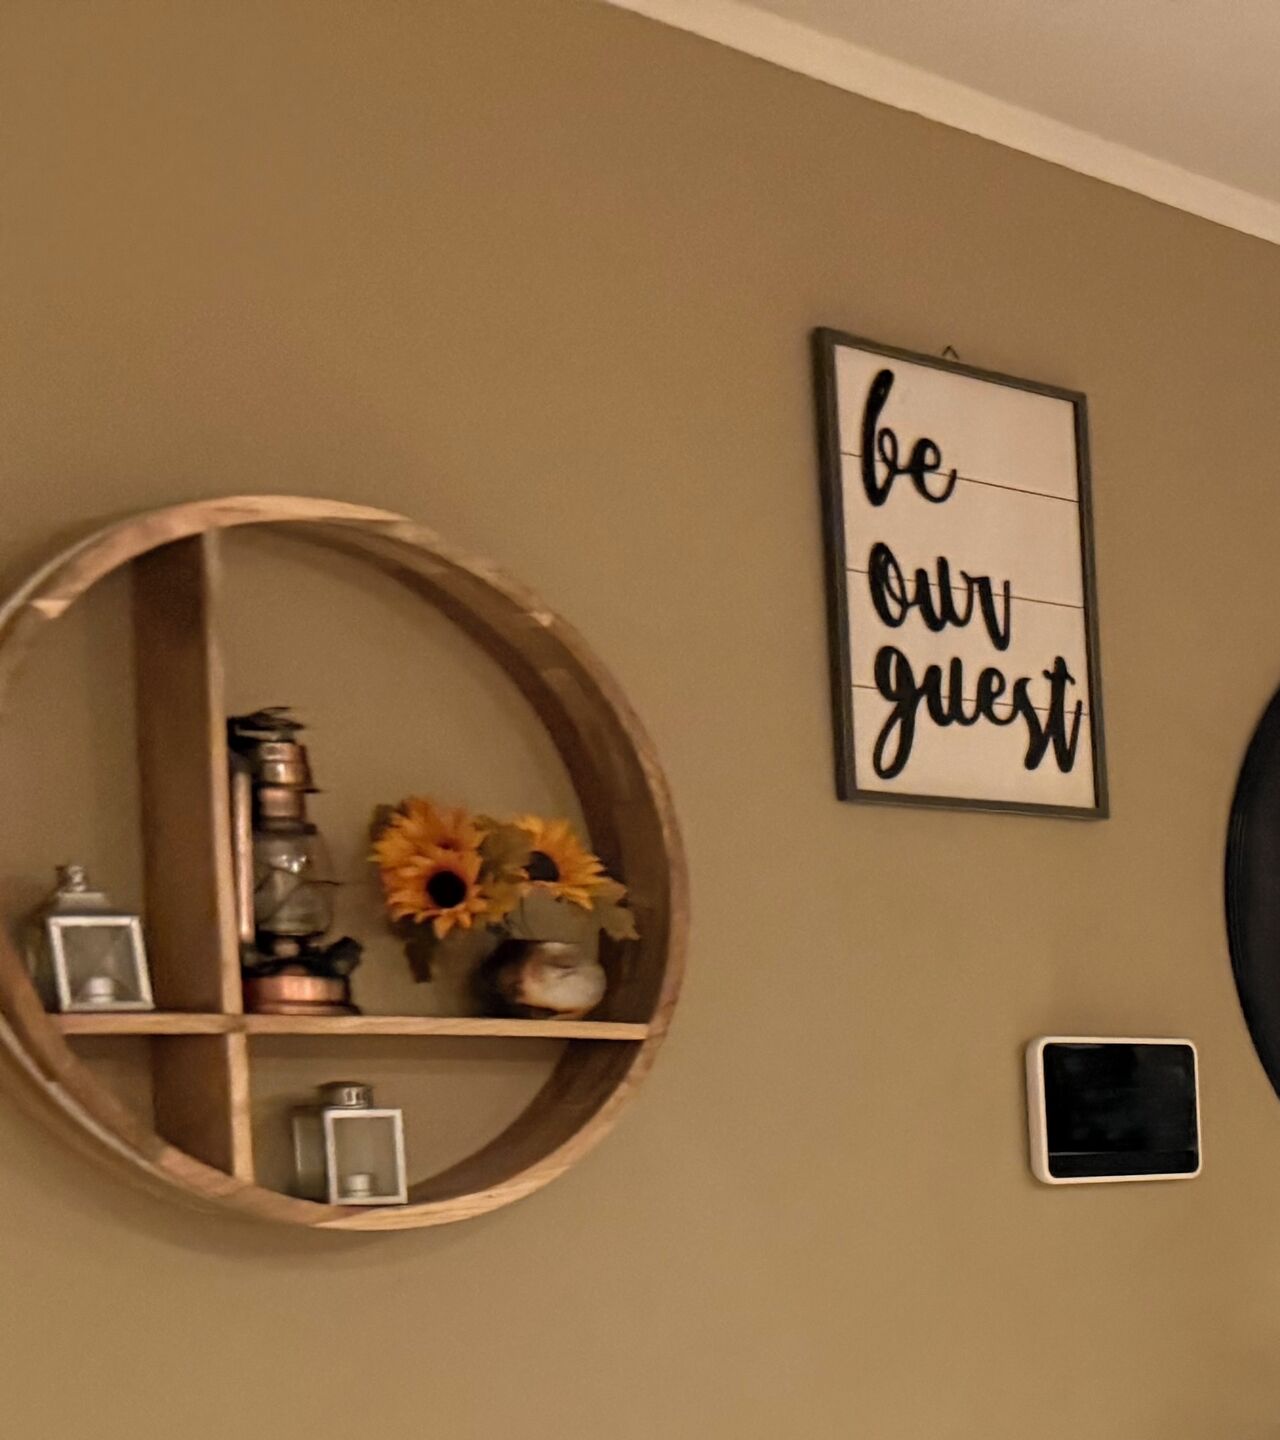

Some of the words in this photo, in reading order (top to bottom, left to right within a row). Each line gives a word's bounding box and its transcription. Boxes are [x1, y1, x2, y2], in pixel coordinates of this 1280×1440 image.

[861, 368, 957, 506] be
[868, 541, 1011, 652] our
[873, 645, 1083, 780] guest
